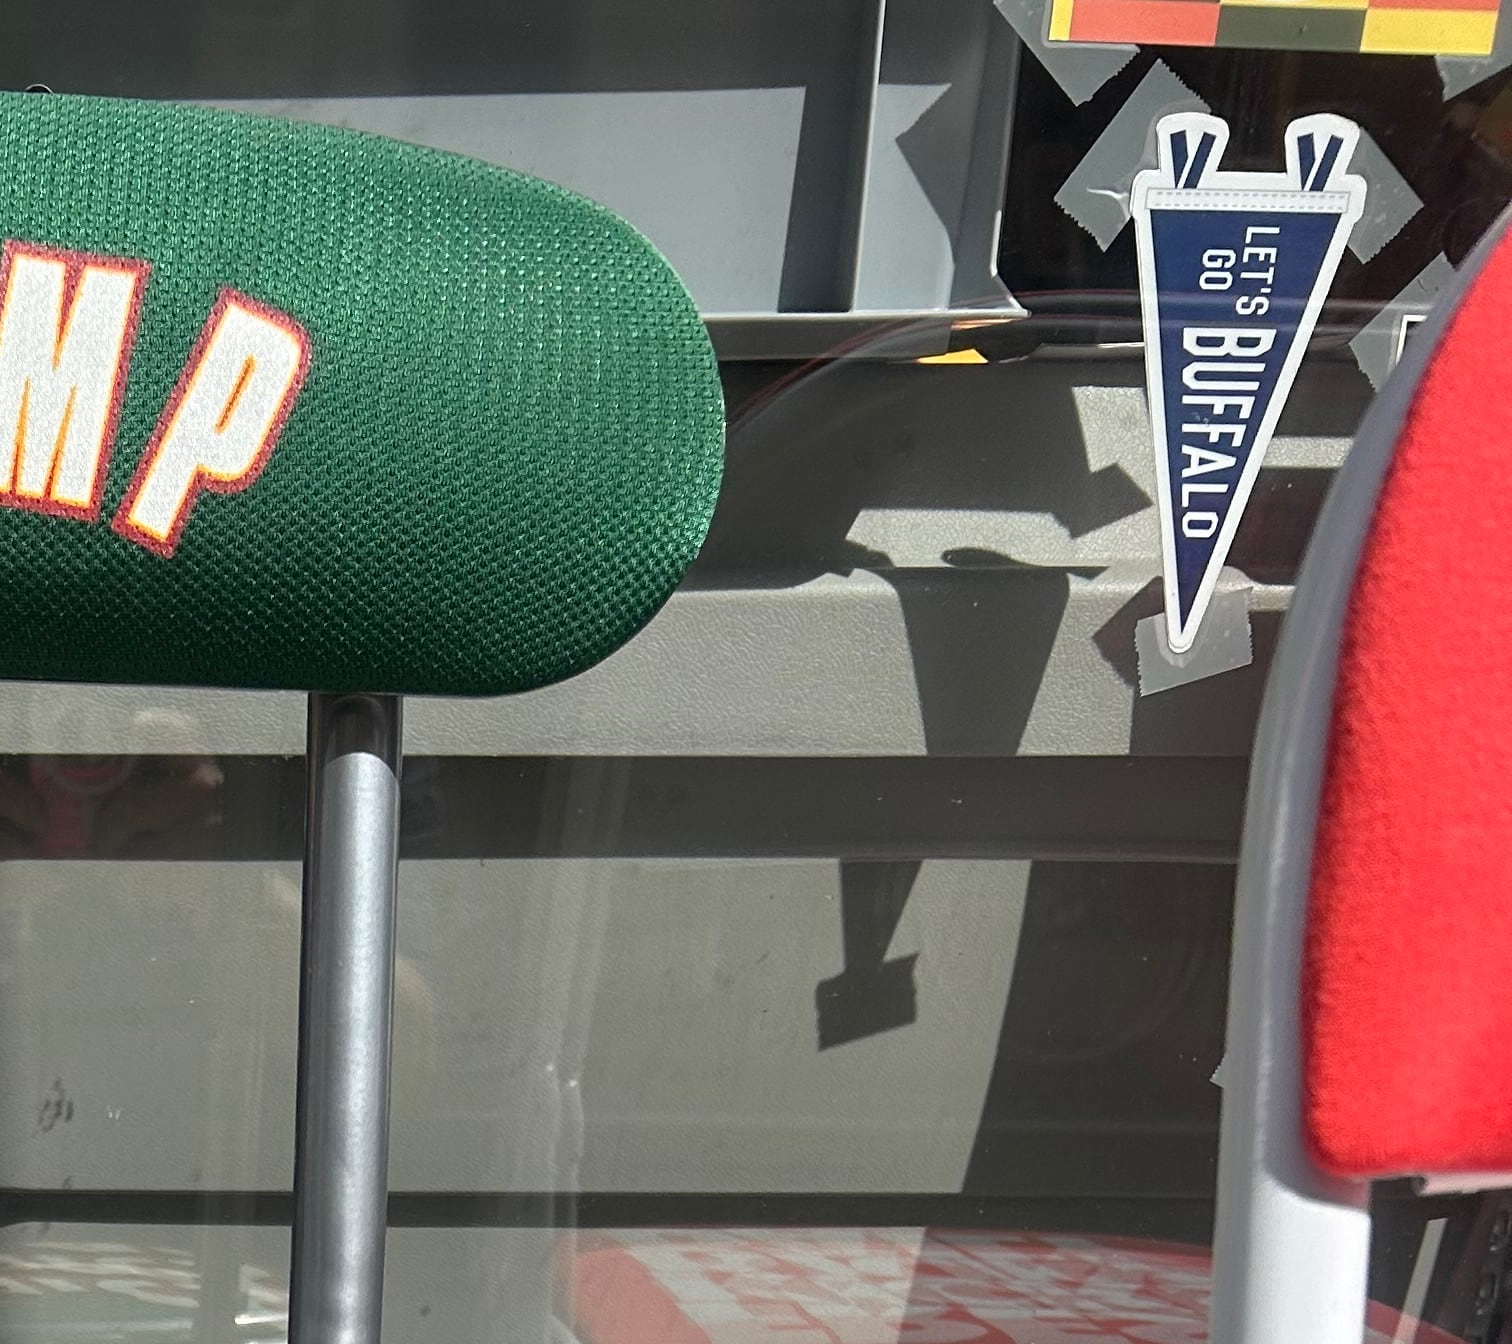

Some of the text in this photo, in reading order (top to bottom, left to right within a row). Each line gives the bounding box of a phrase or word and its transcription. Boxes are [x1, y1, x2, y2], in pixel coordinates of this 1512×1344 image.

[1199, 248, 1237, 291] GO
[1235, 225, 1281, 317] LET'S
[1180, 326, 1278, 539] BUFFALO
